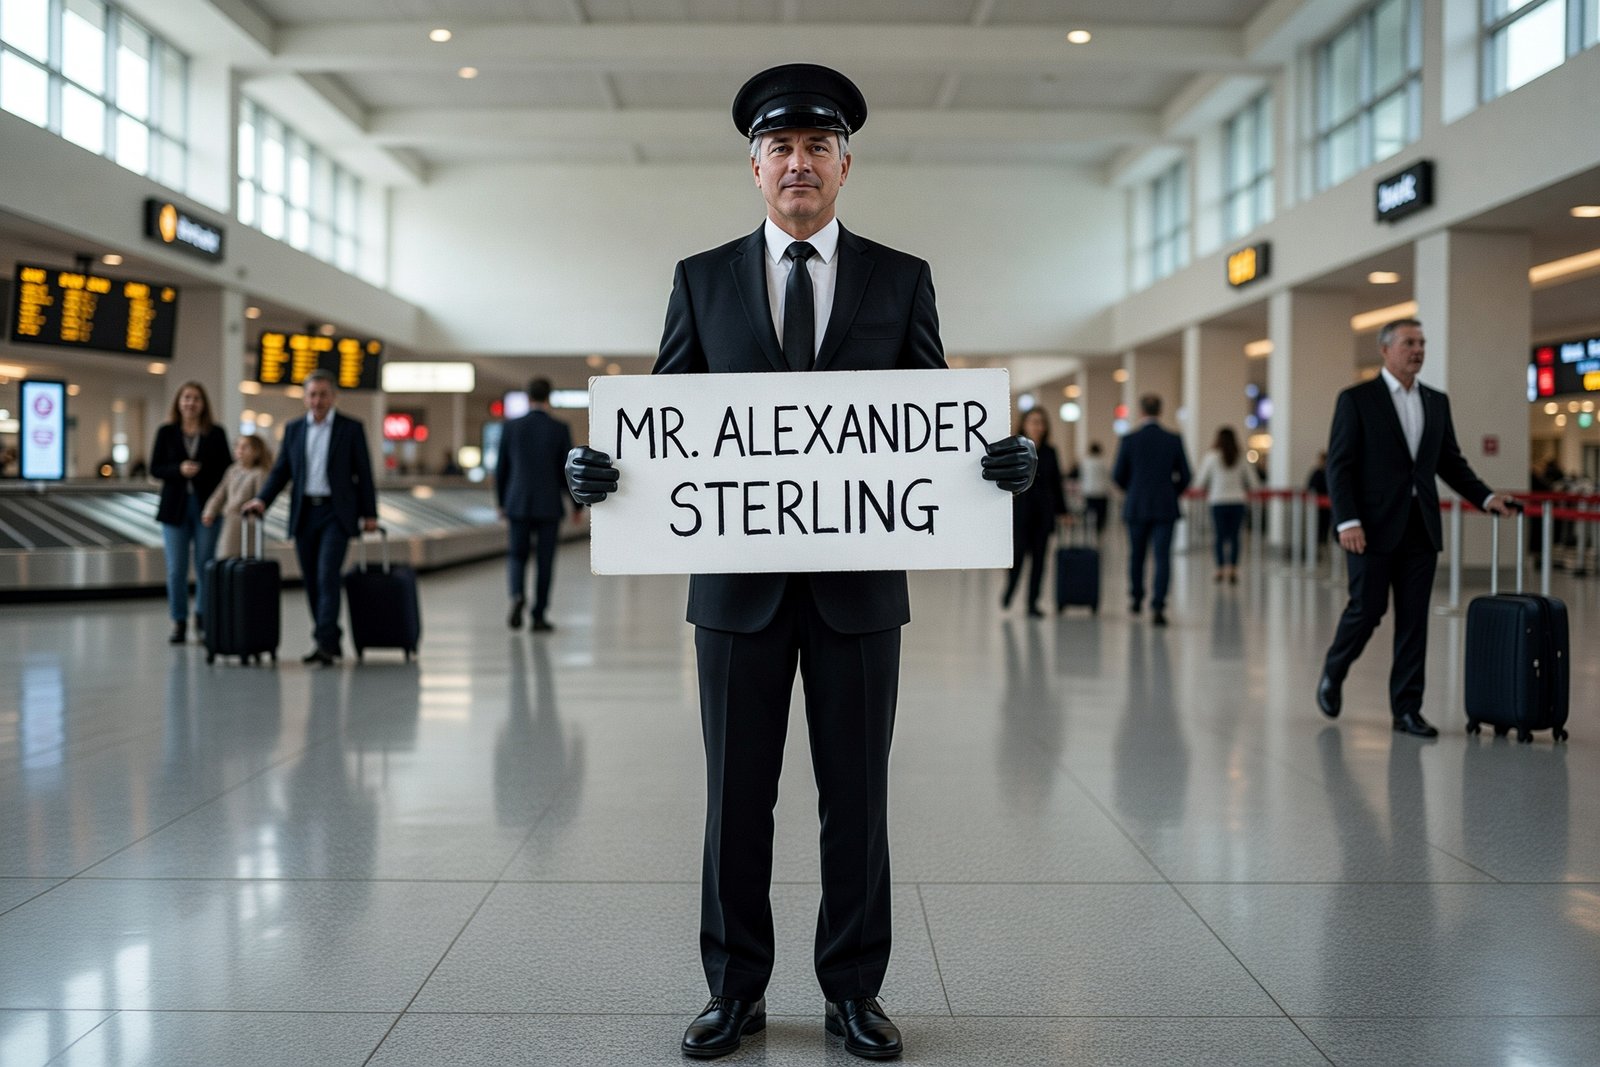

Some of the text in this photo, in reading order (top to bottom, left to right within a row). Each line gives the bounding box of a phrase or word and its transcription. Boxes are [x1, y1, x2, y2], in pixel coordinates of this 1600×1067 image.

[616, 400, 990, 460] MR. ALEXANDER
[669, 479, 940, 538] STERLING
